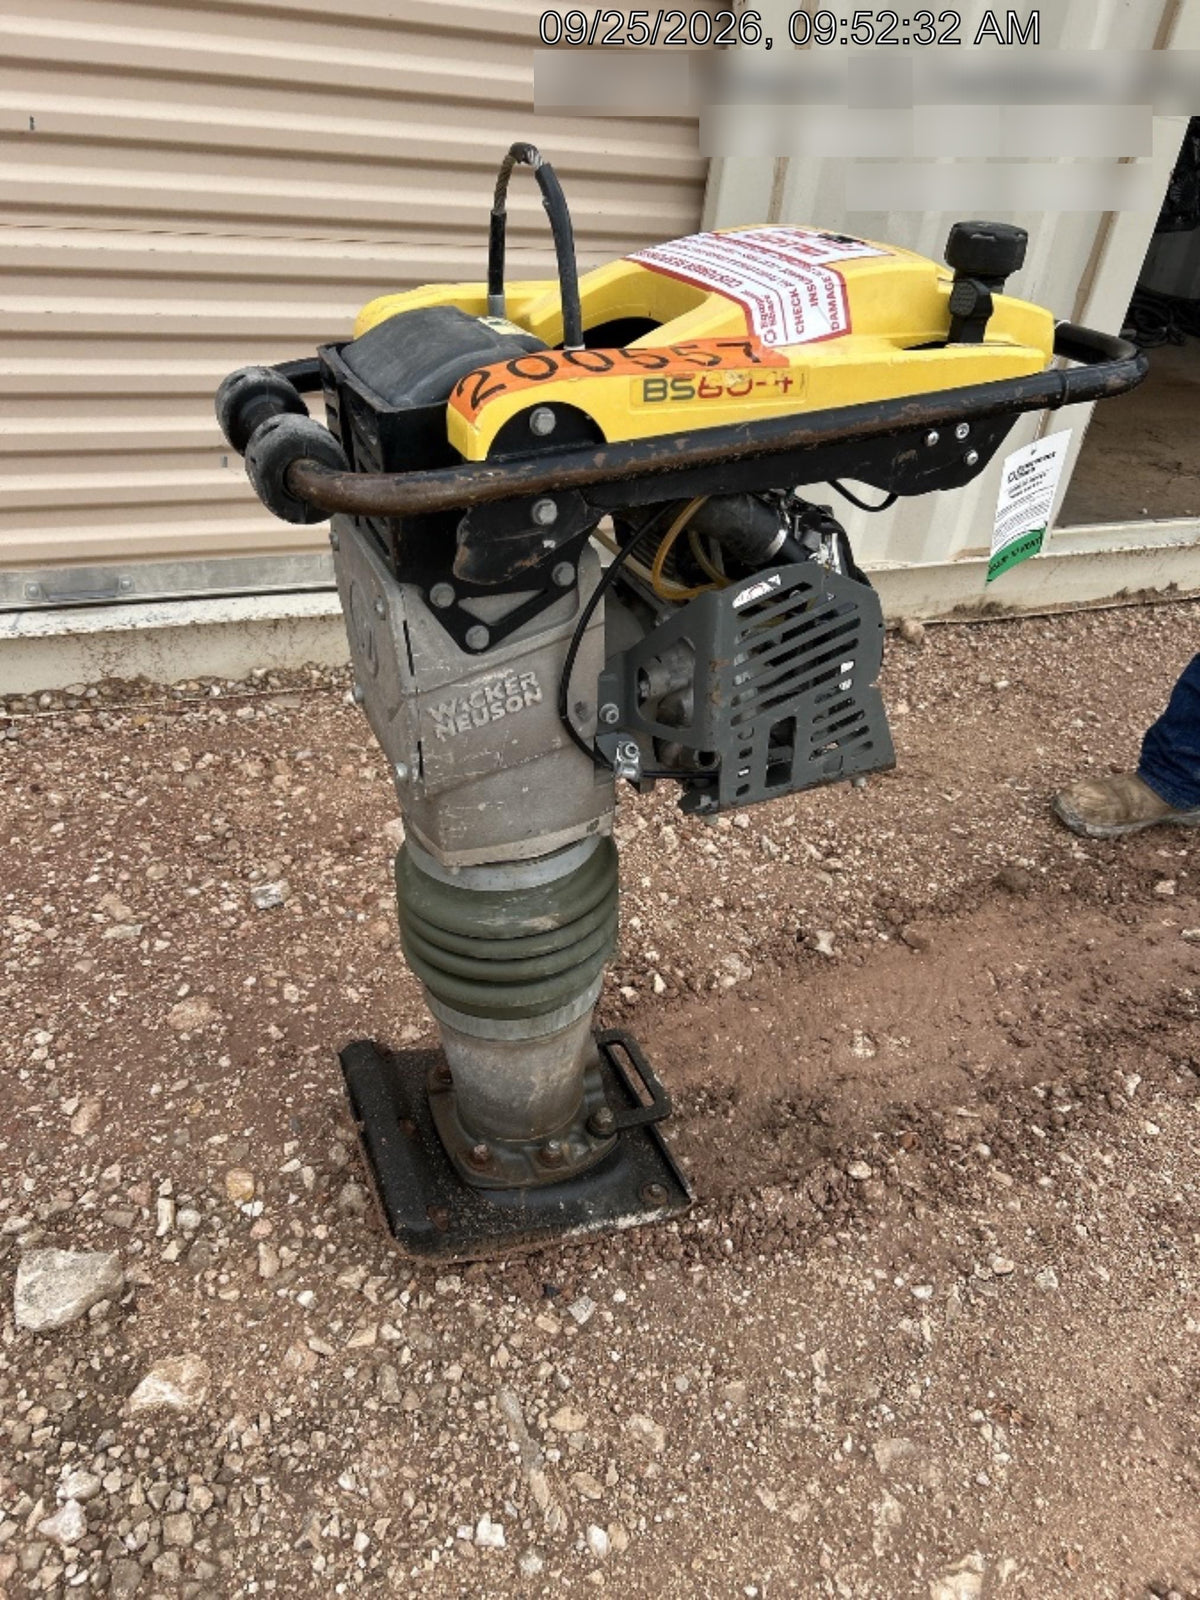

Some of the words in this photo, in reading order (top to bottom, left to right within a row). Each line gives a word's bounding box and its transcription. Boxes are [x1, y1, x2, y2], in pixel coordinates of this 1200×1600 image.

[789, 288, 804, 335] CHECK
[821, 275, 840, 331] DAMAGE
[456, 340, 762, 411] 200557
[426, 671, 539, 723] WACKER
[433, 685, 542, 742] NEUSON
